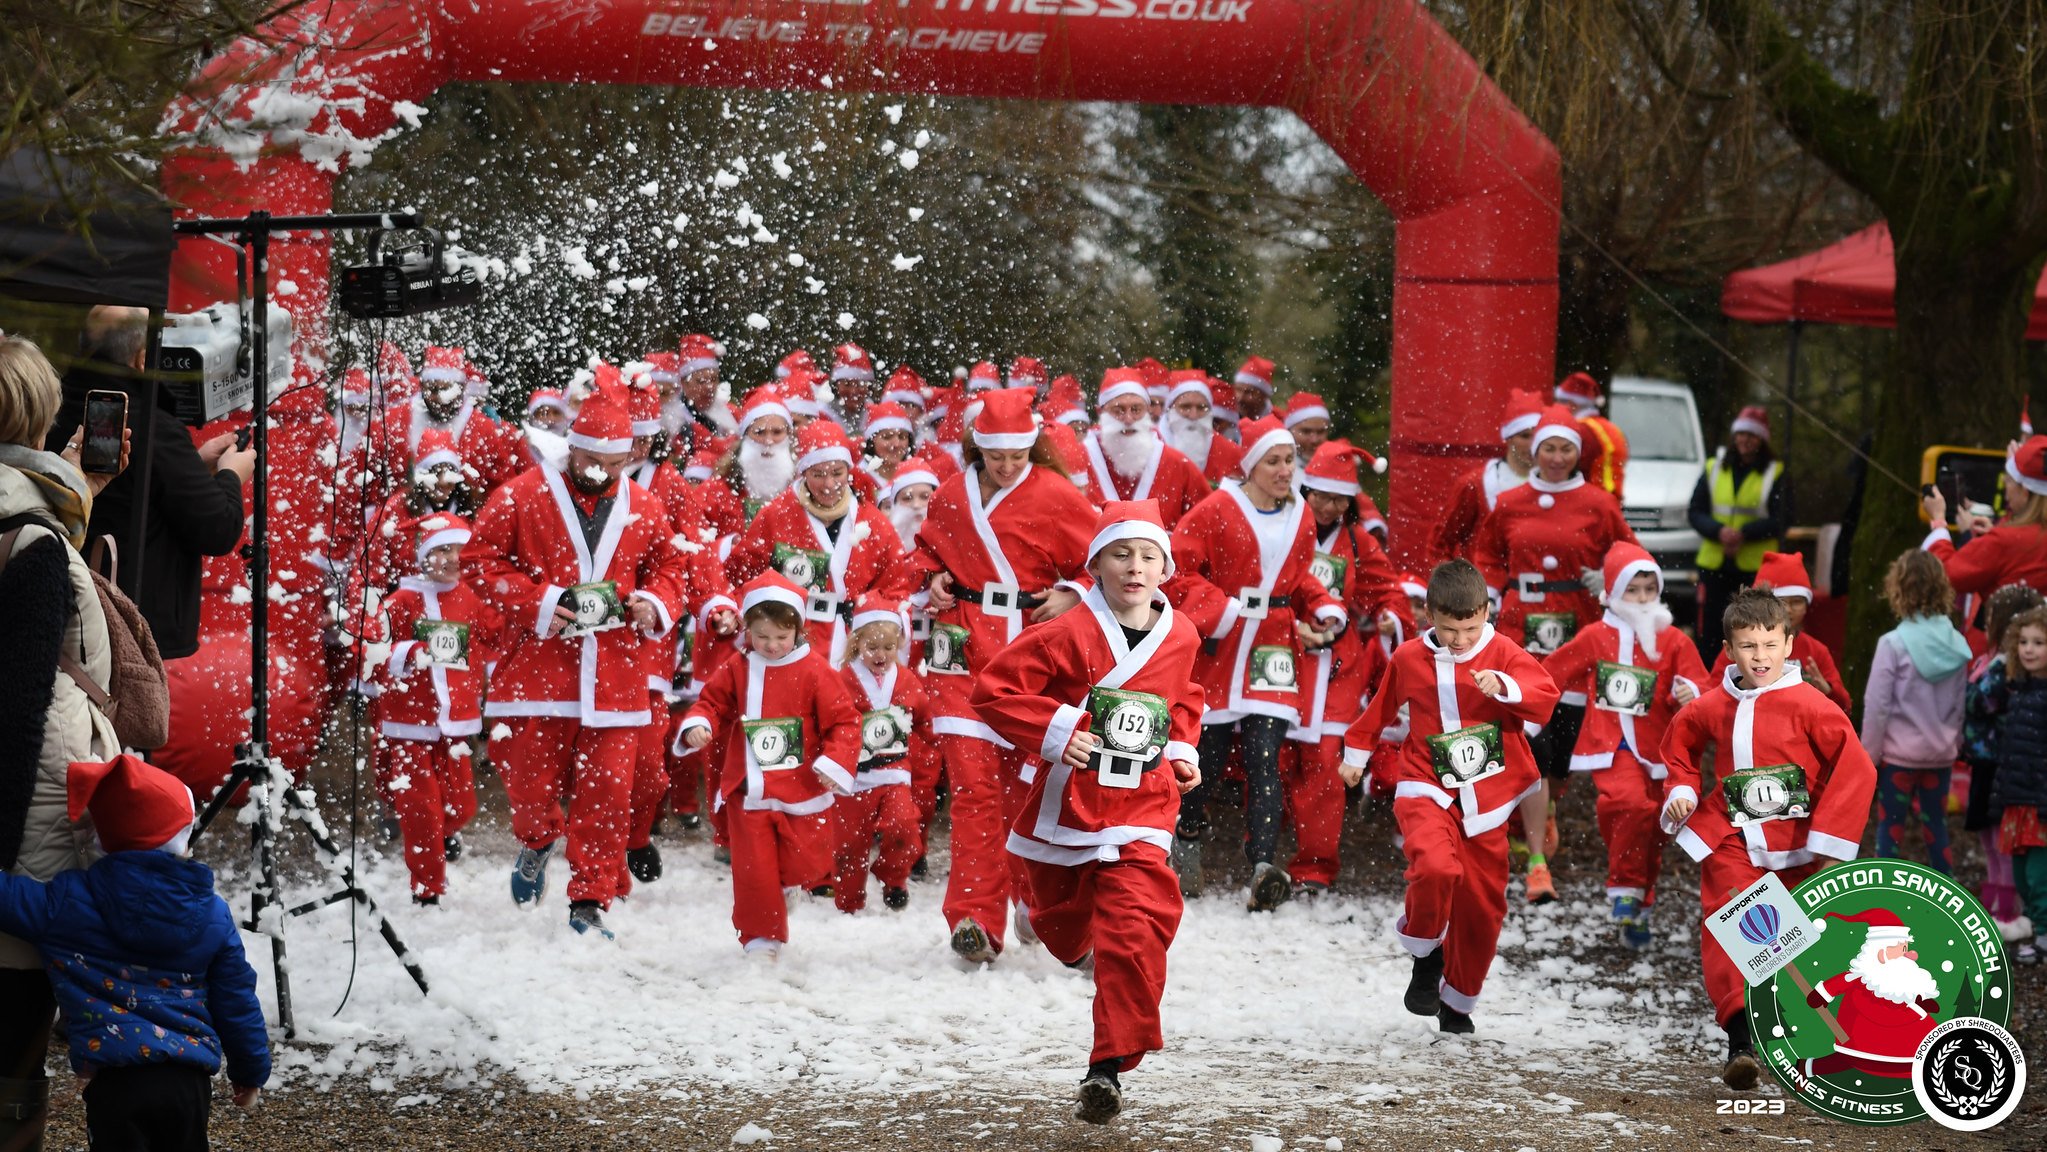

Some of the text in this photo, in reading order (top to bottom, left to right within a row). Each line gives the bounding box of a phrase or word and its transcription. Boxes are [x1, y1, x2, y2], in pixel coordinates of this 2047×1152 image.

[641, 13, 1047, 54] BELIEVE TO ACHIEVE
[410, 280, 430, 290] NEBULA
[212, 373, 239, 392] S-1500
[228, 386, 244, 399] SNOW
[792, 563, 805, 576] 68
[582, 599, 596, 614] 69
[436, 636, 455, 649] 120
[1274, 660, 1290, 673] 148
[1615, 680, 1628, 693] 91
[1118, 713, 1145, 733] 152
[874, 725, 887, 739] 66
[762, 736, 777, 750] 67
[1461, 746, 1475, 763] 12
[1757, 786, 1772, 802] 11
